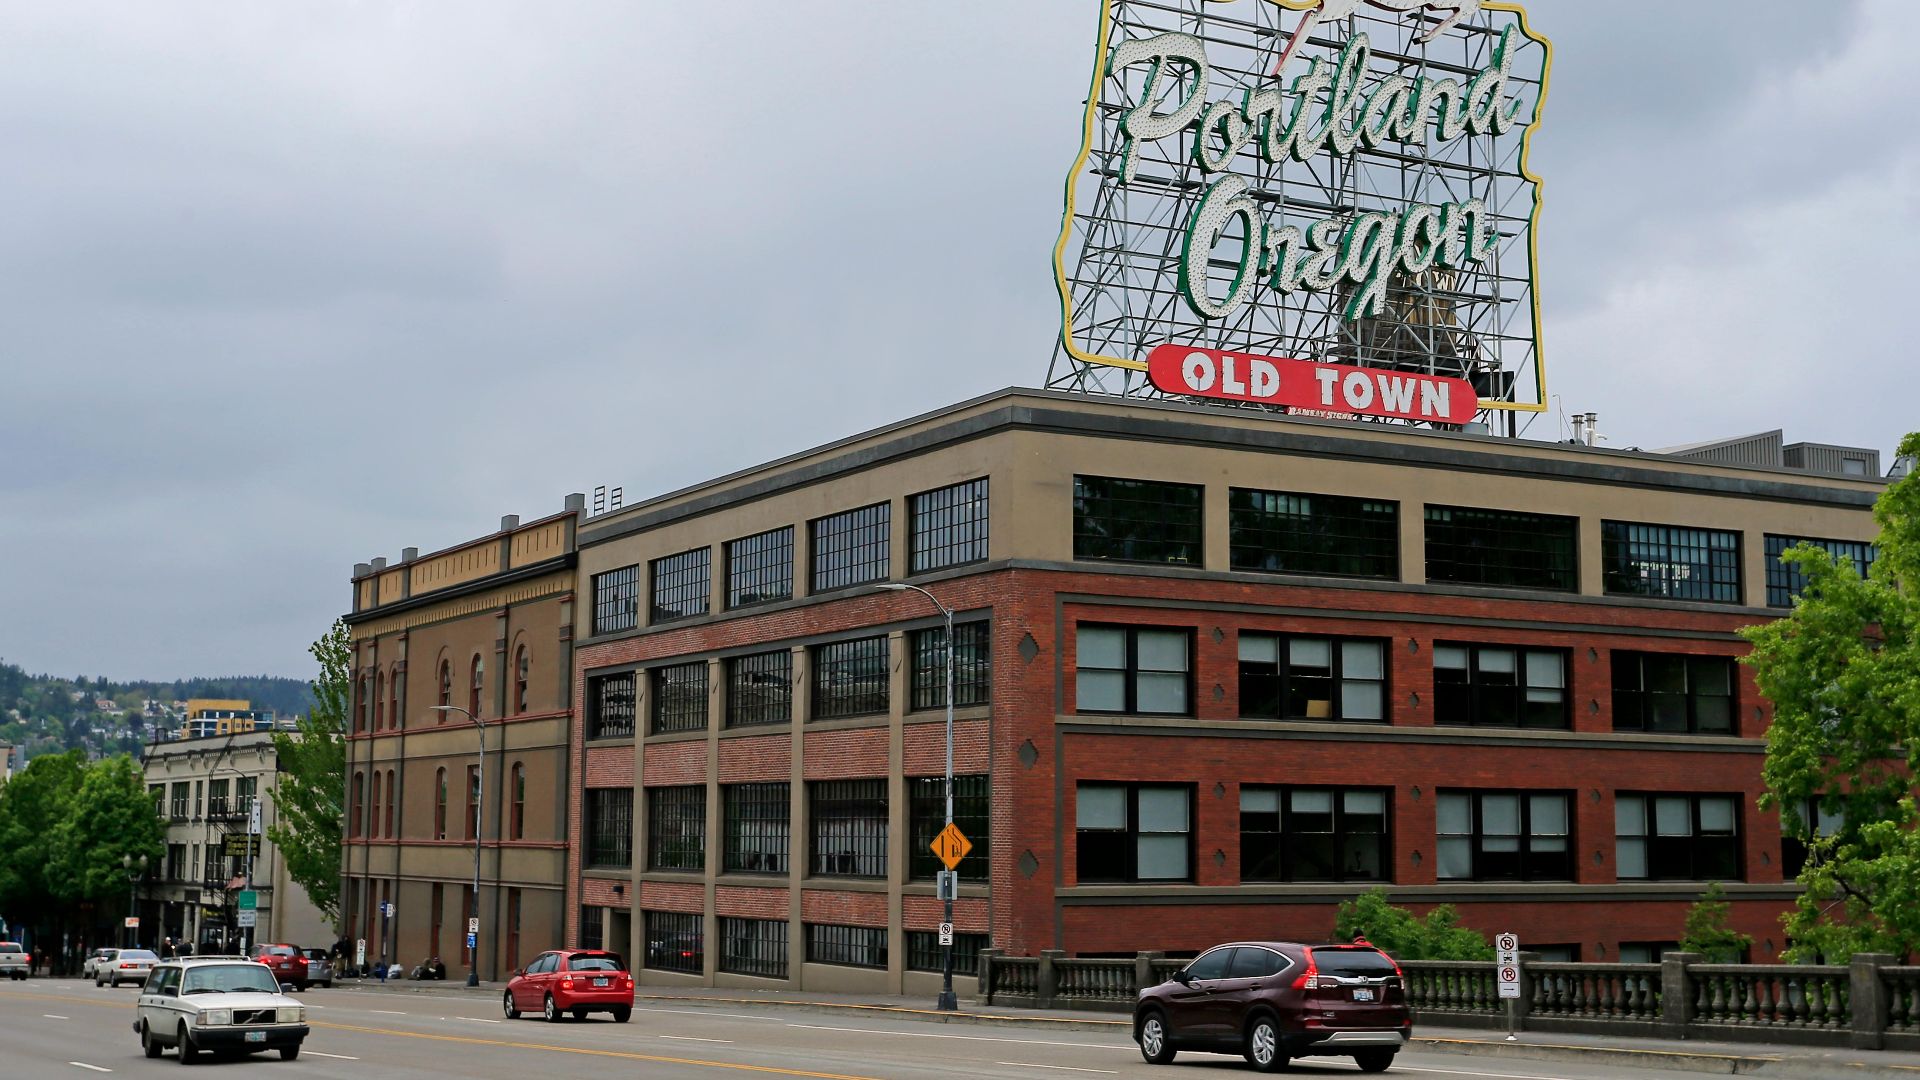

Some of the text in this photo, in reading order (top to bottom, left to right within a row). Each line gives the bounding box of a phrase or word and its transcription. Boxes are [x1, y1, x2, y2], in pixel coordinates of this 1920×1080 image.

[1106, 23, 1522, 186] Portland
[1180, 174, 1501, 321] Oregon
[1181, 351, 1450, 418] OLD TOWN
